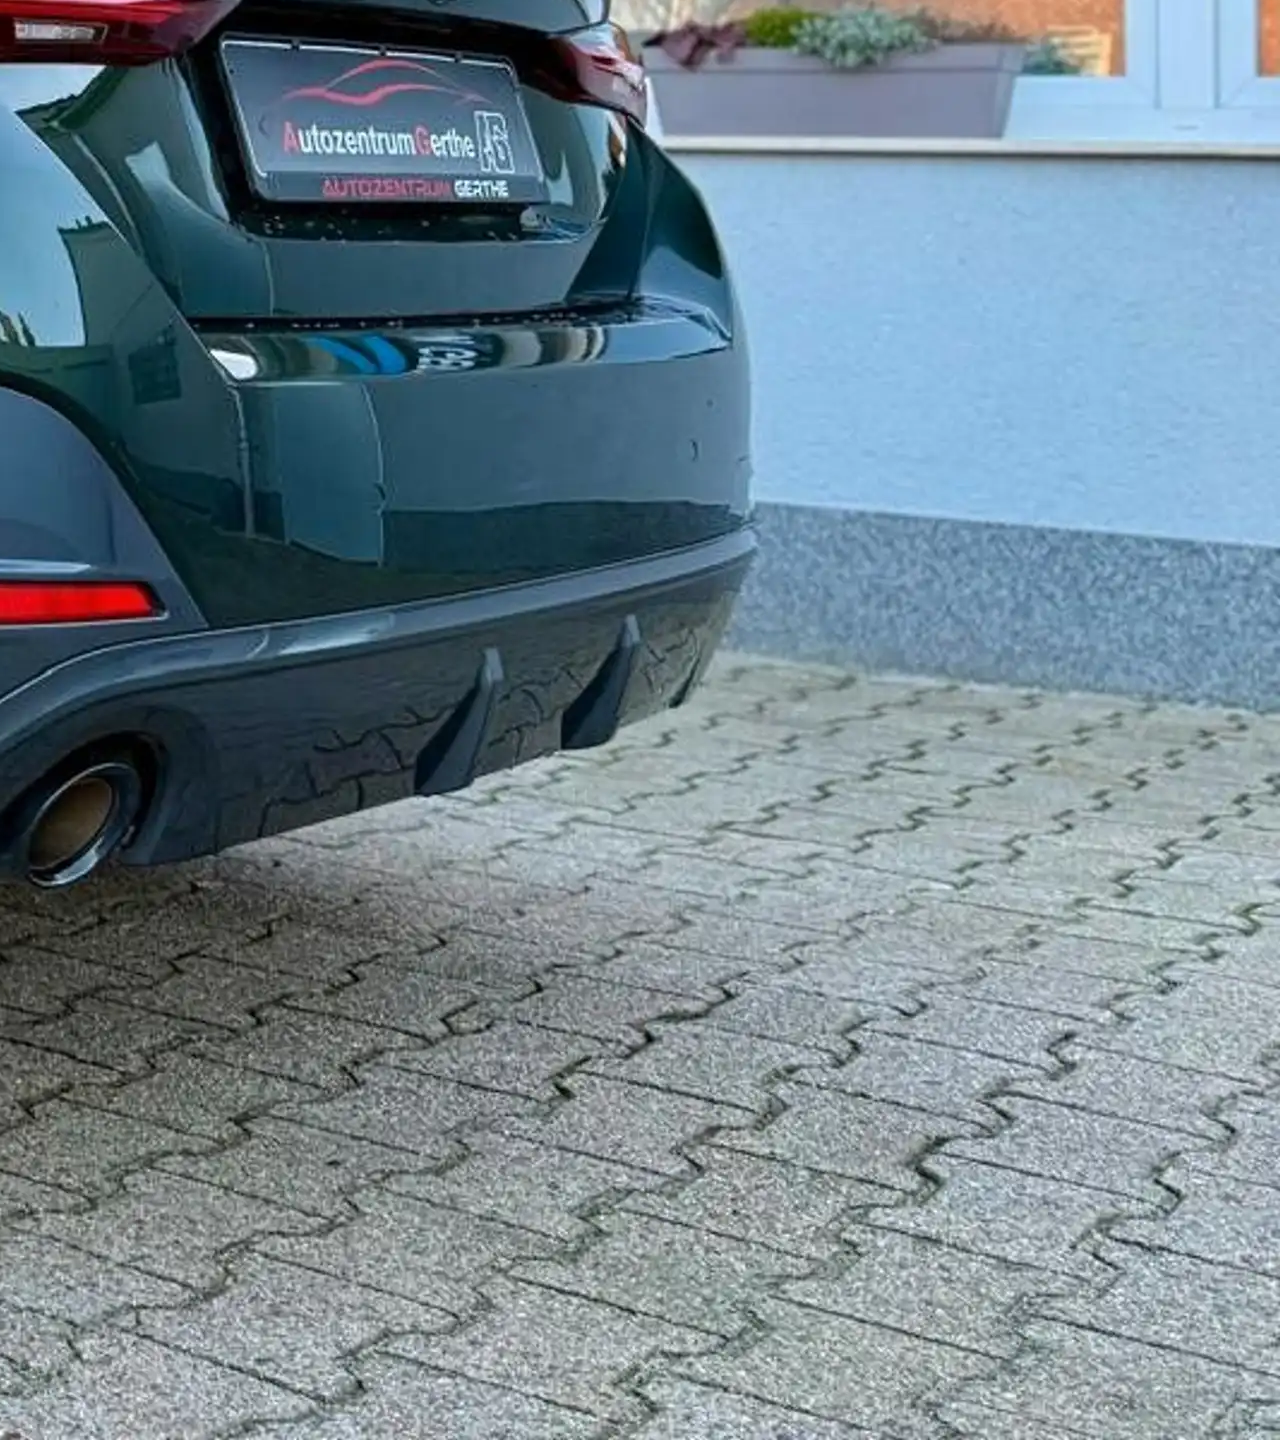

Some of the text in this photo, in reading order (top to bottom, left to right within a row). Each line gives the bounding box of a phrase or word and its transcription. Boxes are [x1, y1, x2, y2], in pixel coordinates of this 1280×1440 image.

[282, 121, 476, 158] AutozentrumGerthe
[322, 174, 510, 199] AUTOZENTRUM GERTHE
